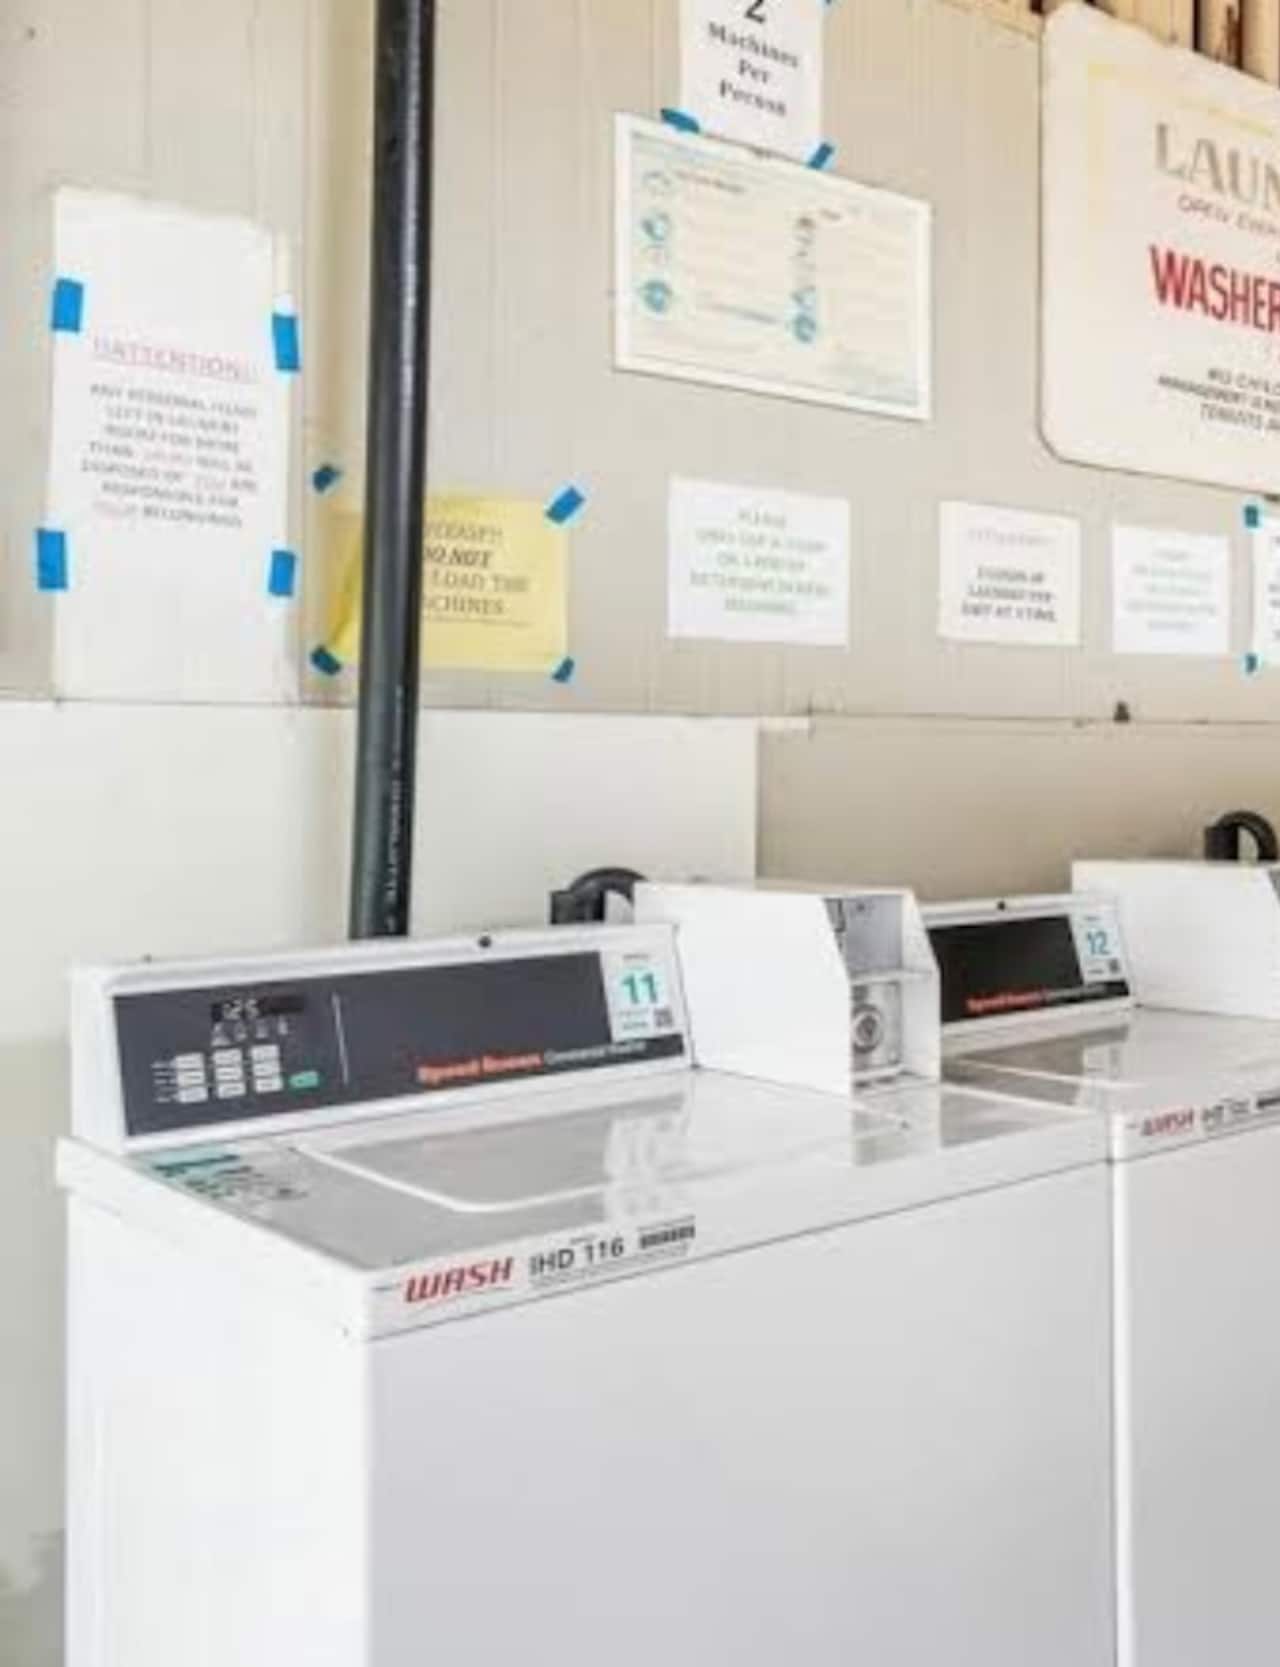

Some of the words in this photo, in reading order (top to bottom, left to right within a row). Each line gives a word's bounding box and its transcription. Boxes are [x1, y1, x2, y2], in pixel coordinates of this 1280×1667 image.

[707, 20, 800, 70] Machines
[738, 58, 770, 84] Per
[718, 79, 787, 118] Person
[449, 548, 493, 569] NOT
[1087, 929, 1111, 956] 12
[620, 971, 659, 1005] 11
[404, 1256, 515, 1304] WASH
[529, 1248, 577, 1277] IHD
[584, 1236, 625, 1263] 116
